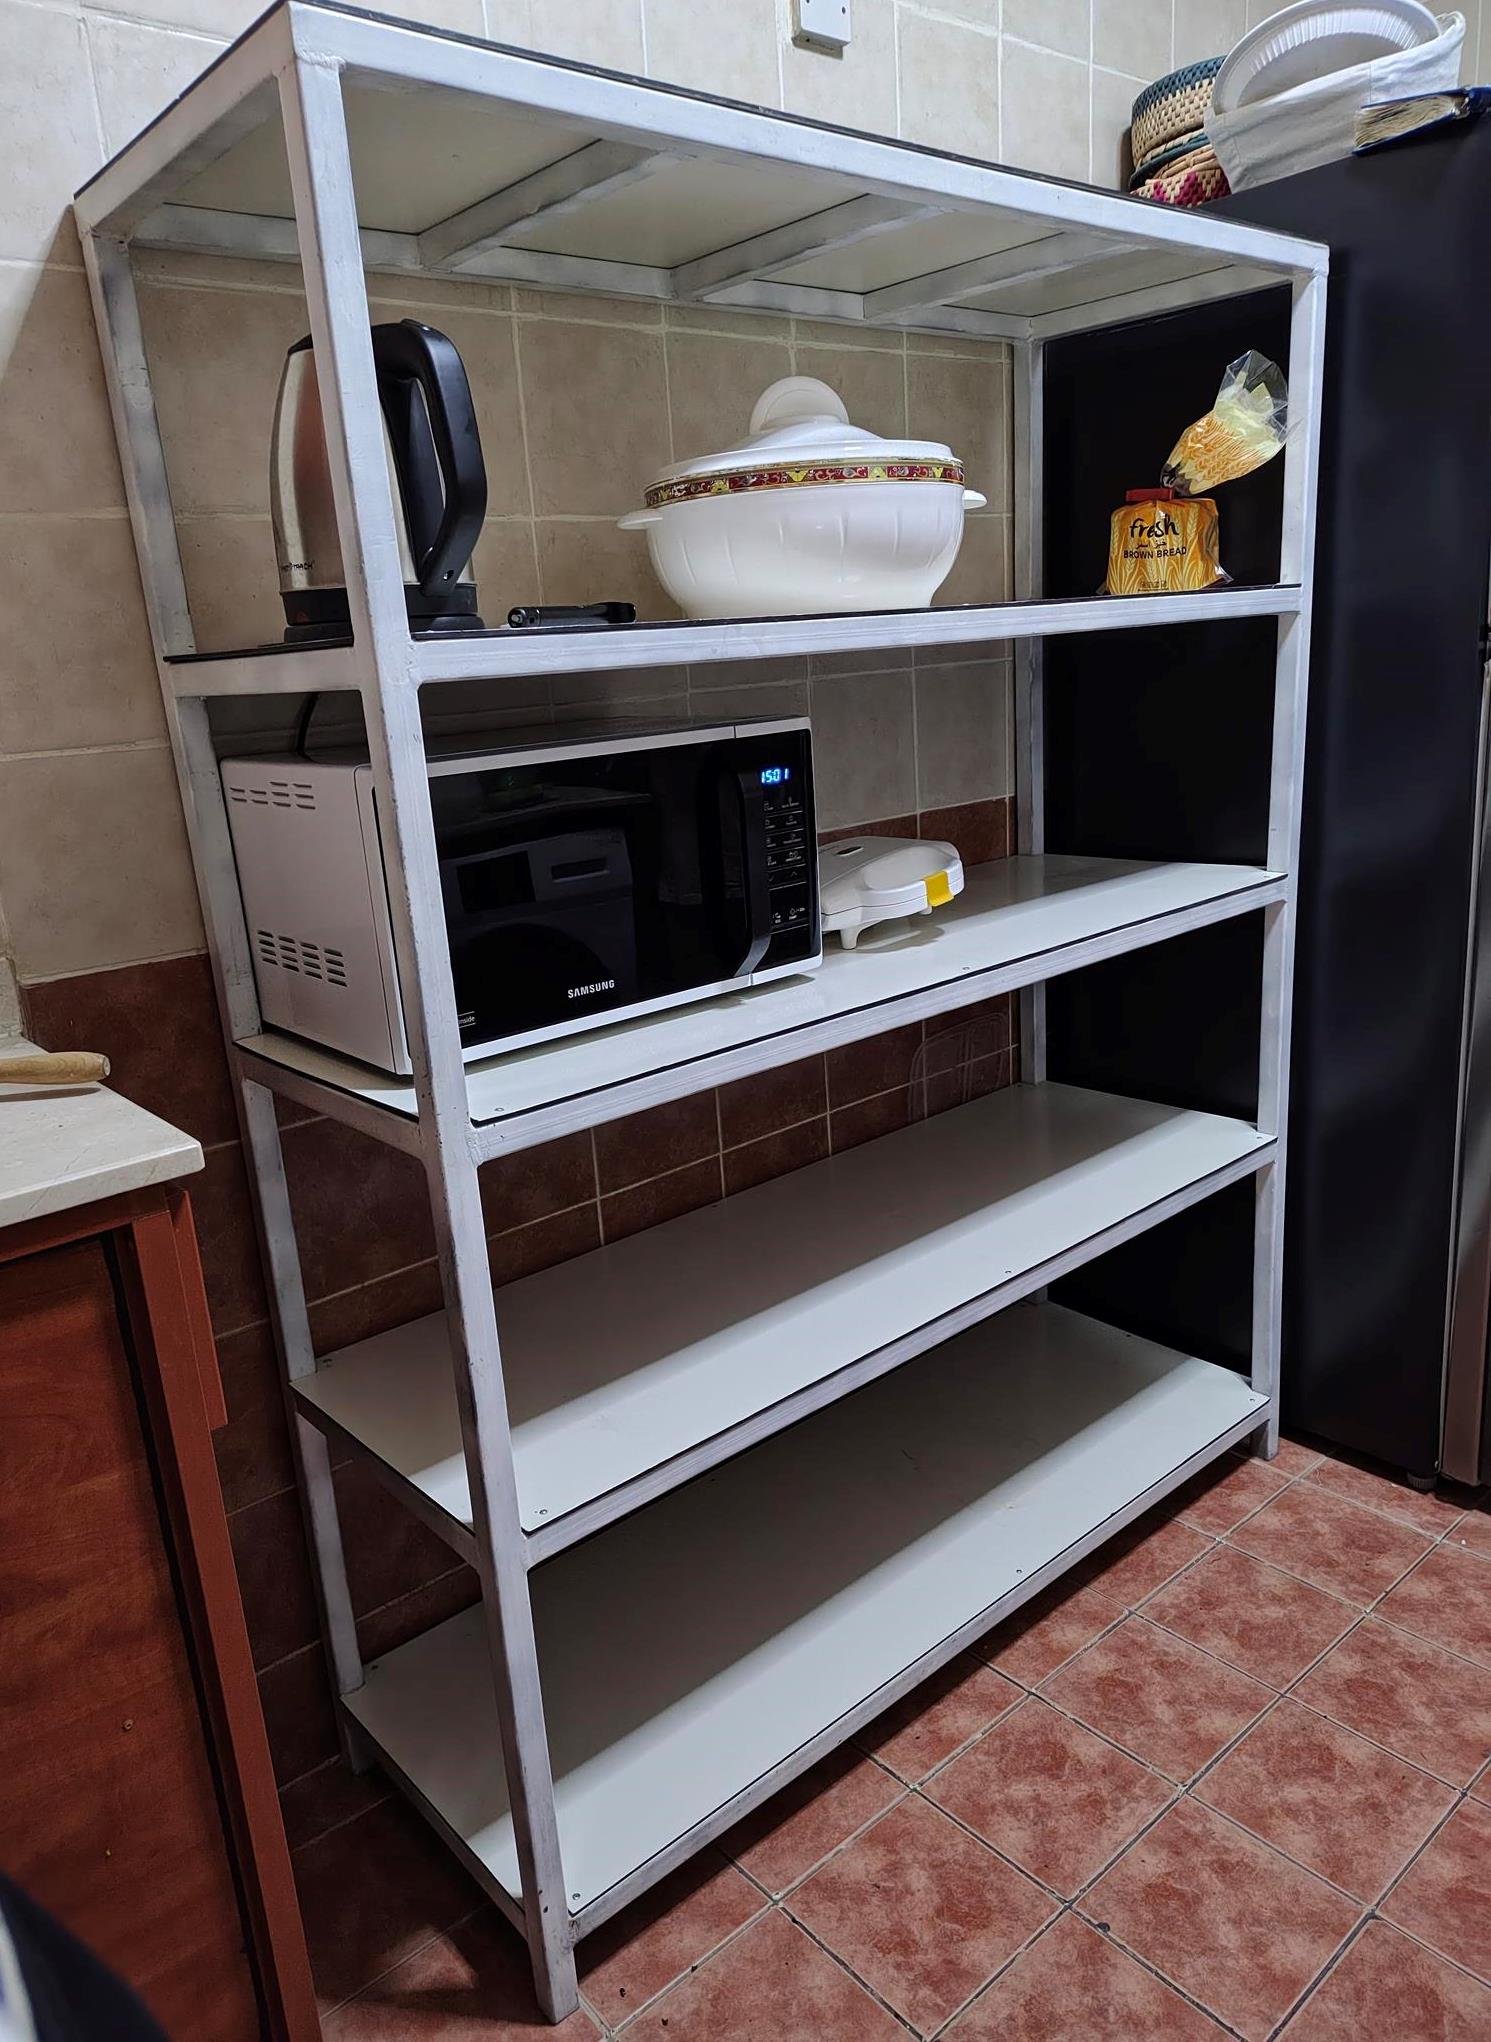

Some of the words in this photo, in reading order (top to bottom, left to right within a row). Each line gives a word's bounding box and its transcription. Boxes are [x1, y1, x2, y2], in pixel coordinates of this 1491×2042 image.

[1130, 513, 1179, 538] fresh
[1123, 550, 1154, 559] BROWN
[1156, 546, 1187, 558] BREAD
[567, 979, 615, 999] SAMSUNG
